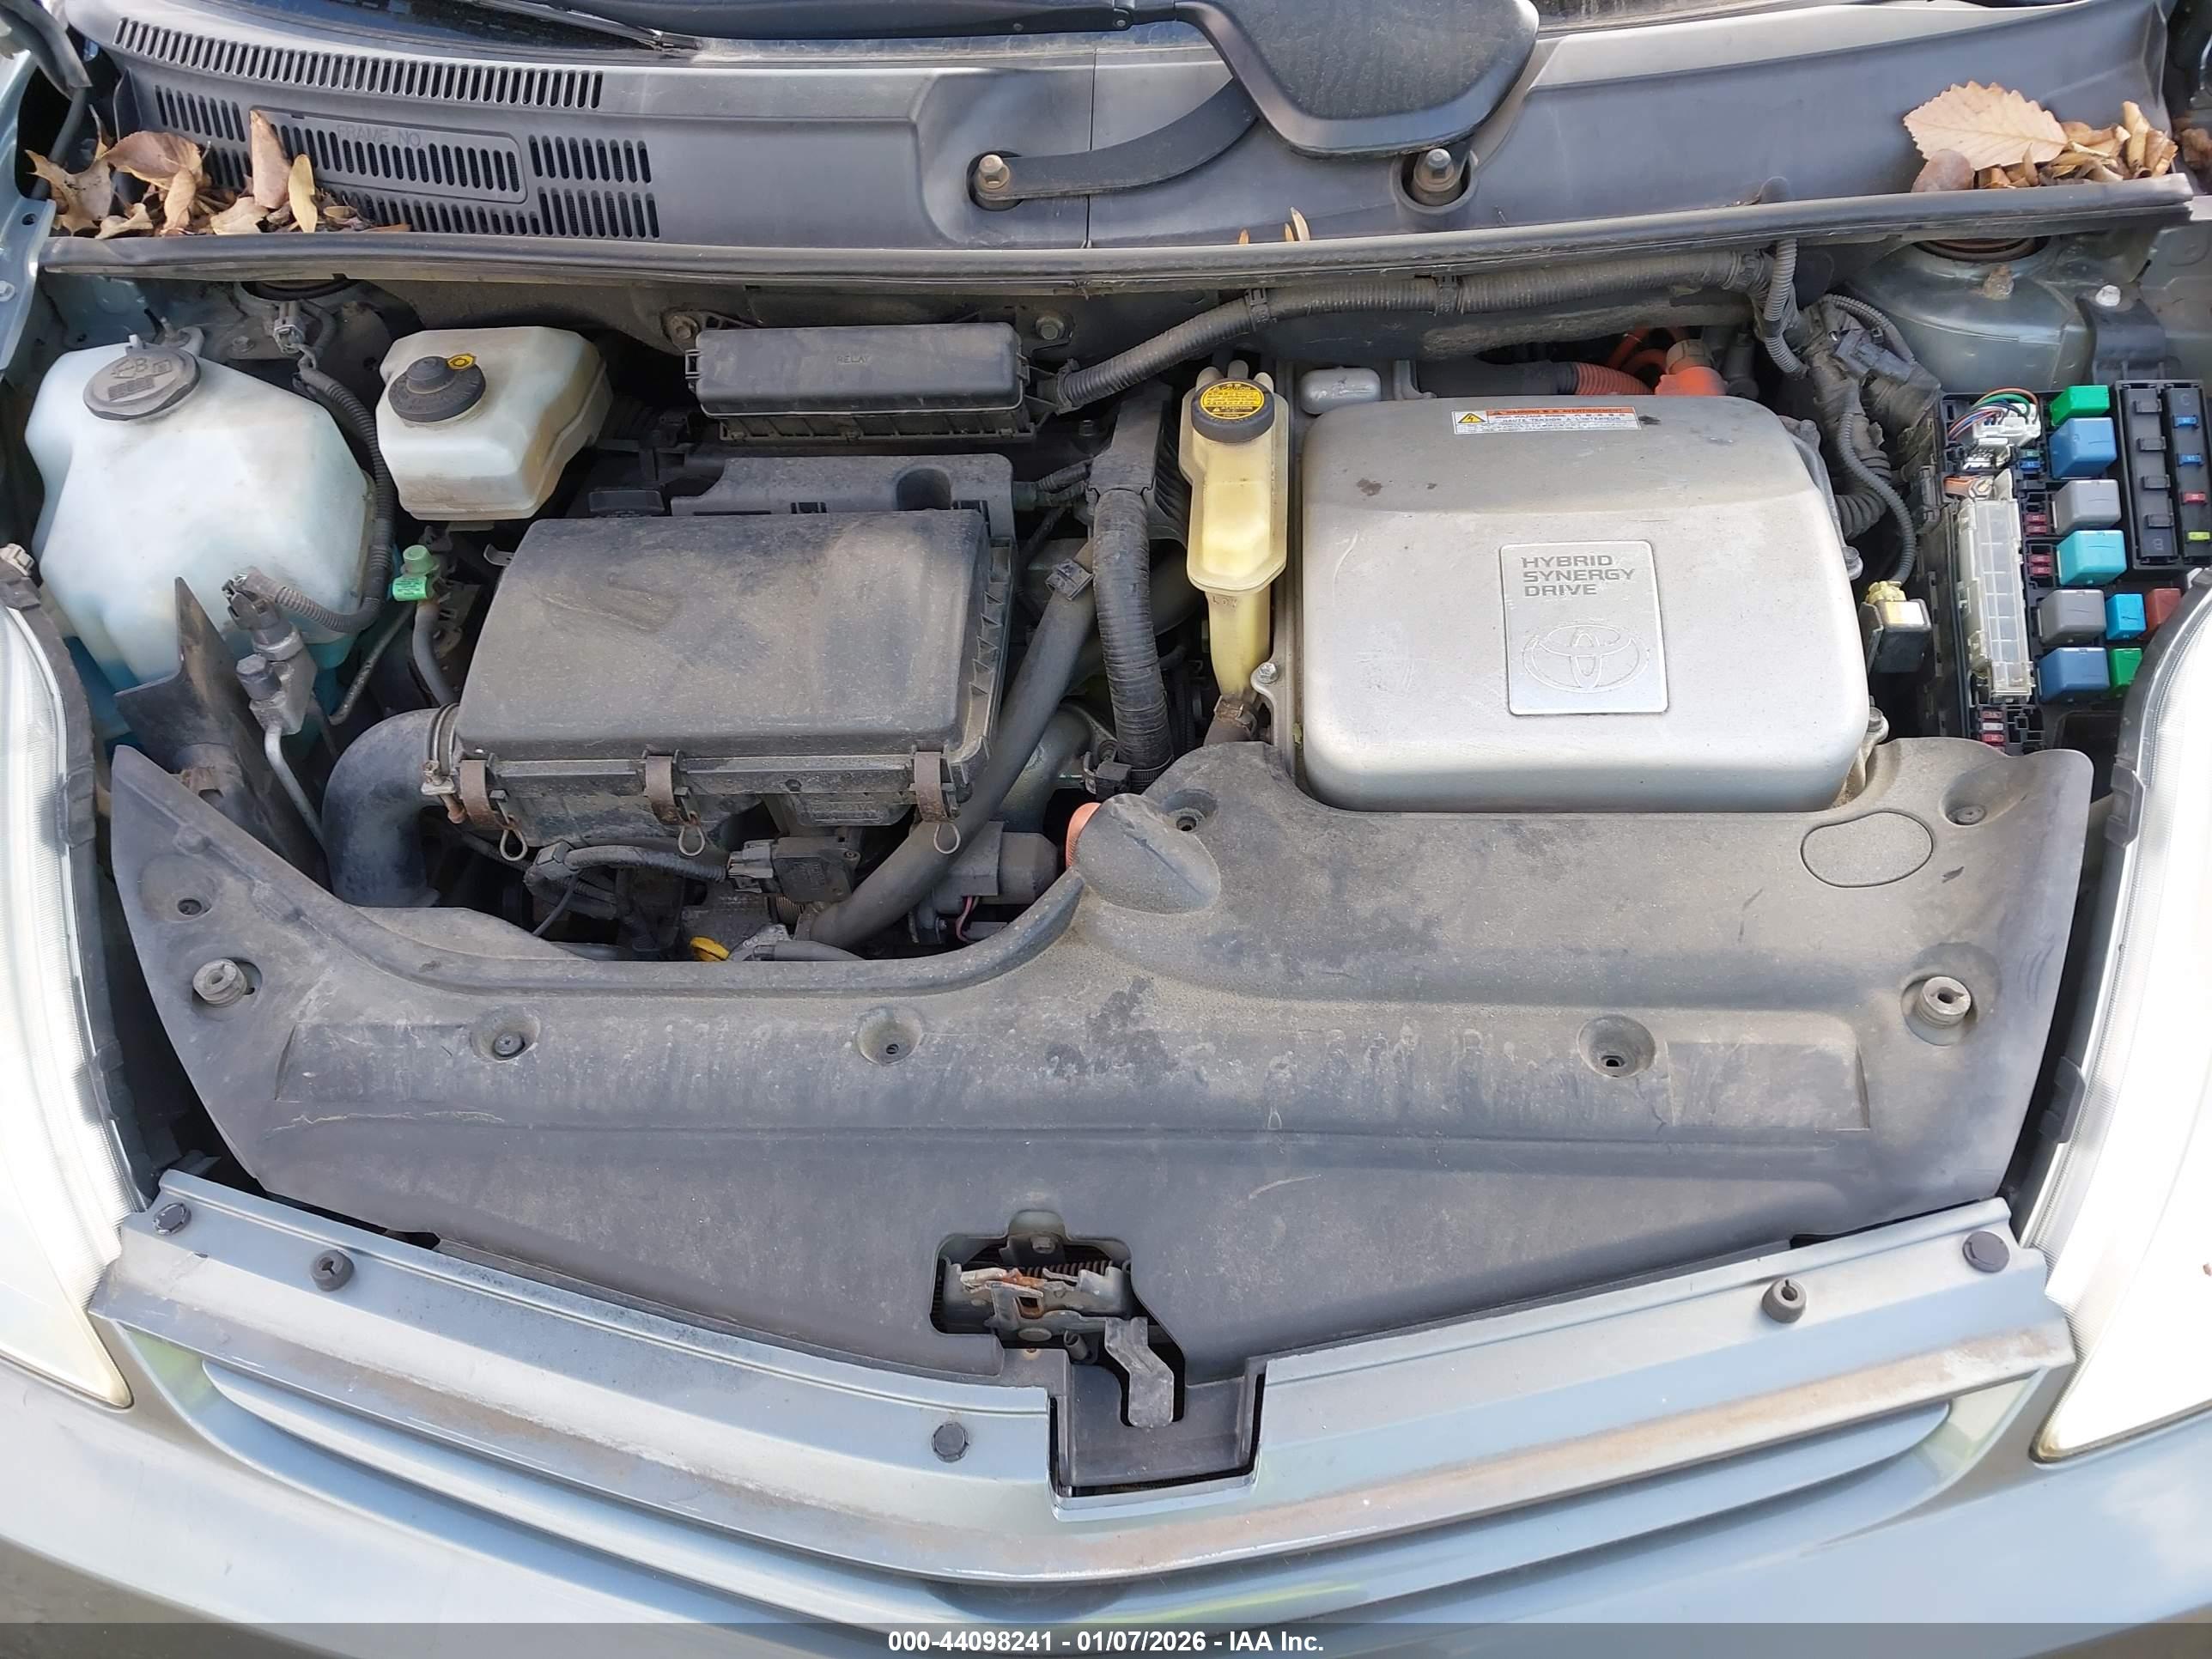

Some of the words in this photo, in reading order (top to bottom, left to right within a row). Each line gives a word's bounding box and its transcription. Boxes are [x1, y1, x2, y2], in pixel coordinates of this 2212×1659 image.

[337, 125, 391, 144] FRAME
[836, 355, 872, 364] RELAY
[1522, 555, 1613, 568] HYBRID
[1523, 568, 1636, 583] SYNERGY
[1524, 584, 1598, 597] DRIVE
